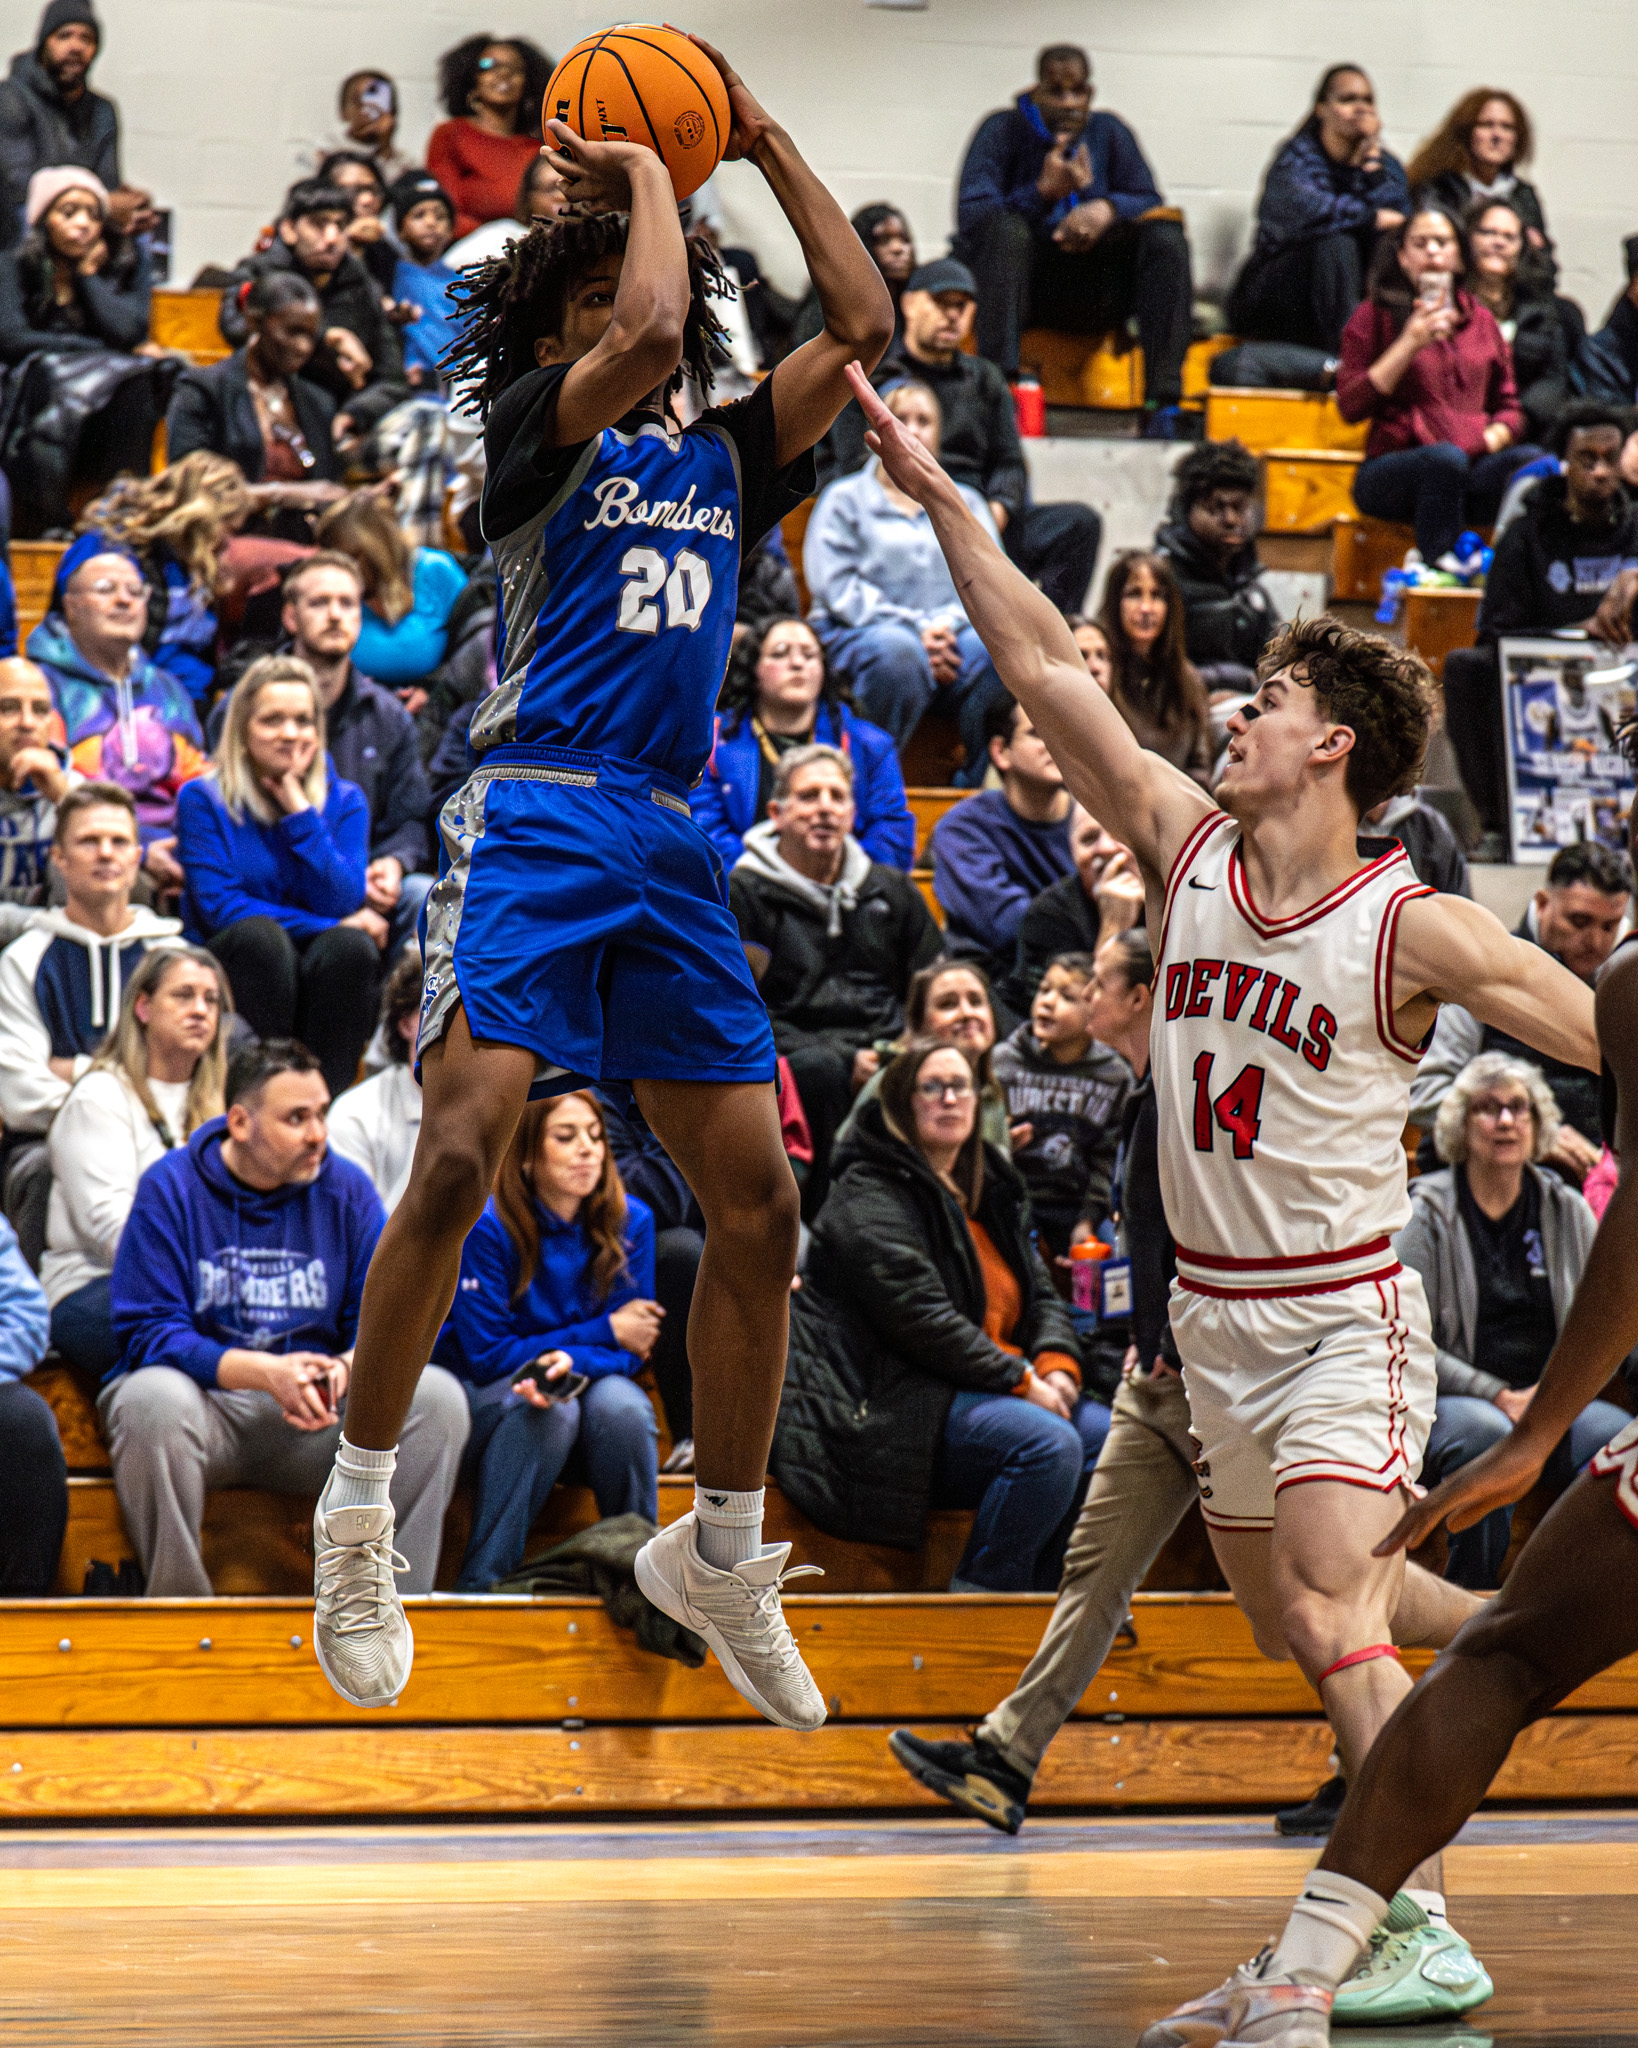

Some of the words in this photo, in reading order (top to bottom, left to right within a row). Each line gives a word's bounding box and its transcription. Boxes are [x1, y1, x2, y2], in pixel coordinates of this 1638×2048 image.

[596, 98, 608, 123] NXT
[584, 477, 736, 541] Bombers
[616, 545, 713, 637] 20
[1166, 959, 1338, 1072] DEVILS
[1193, 1050, 1265, 1159] 14
